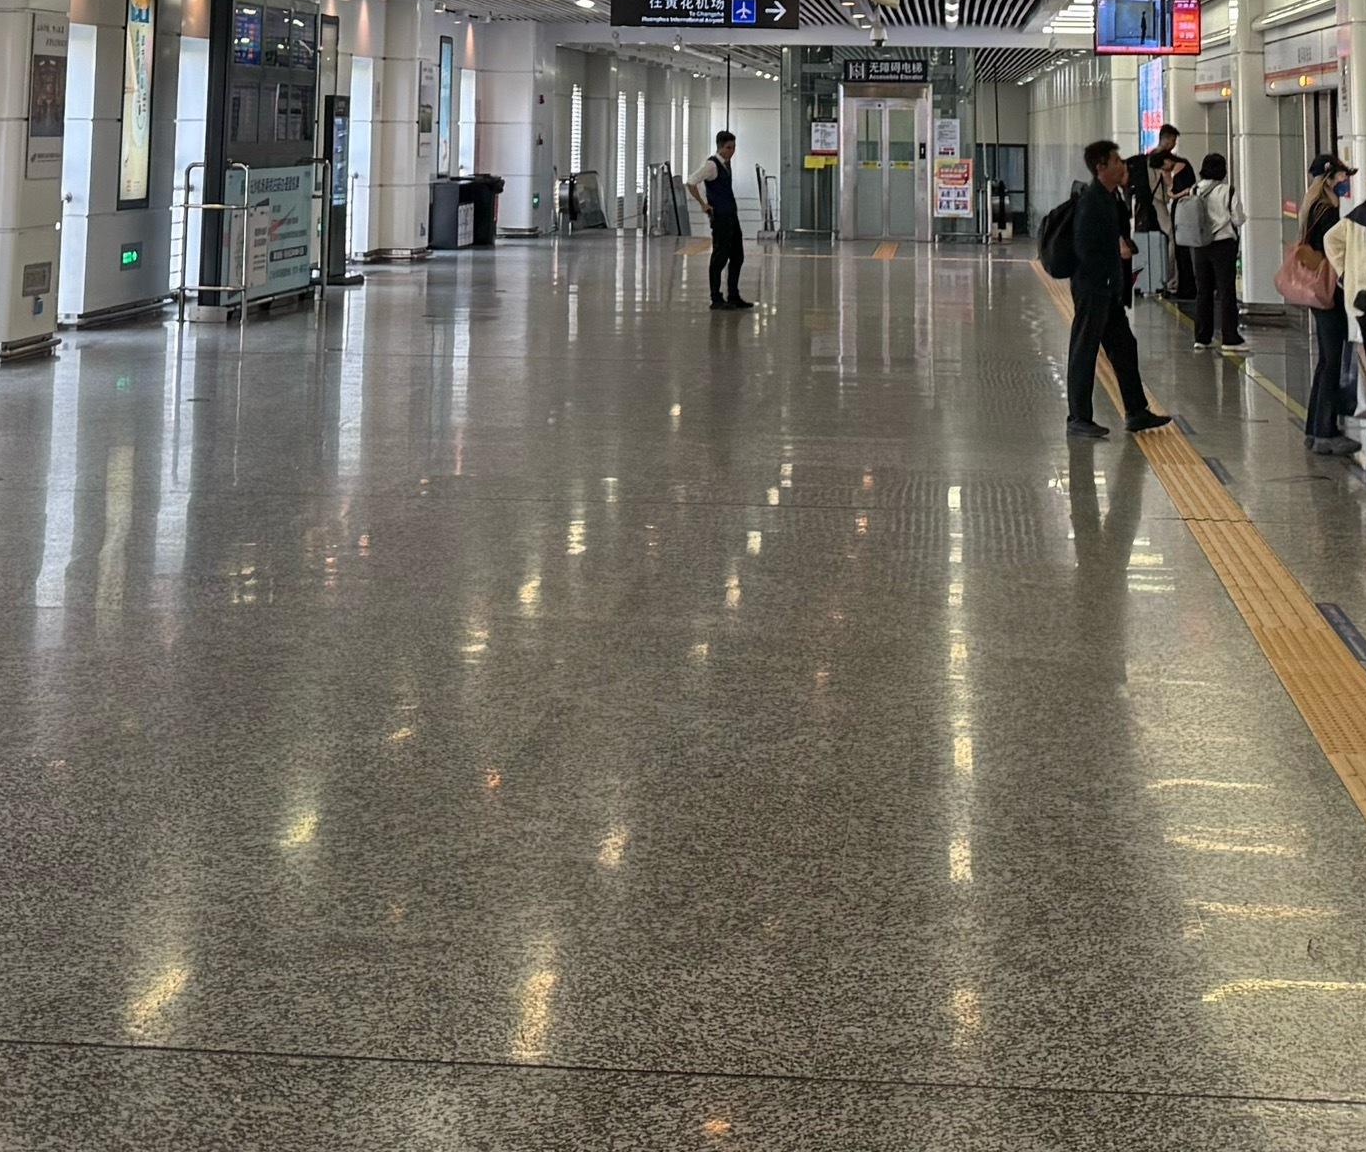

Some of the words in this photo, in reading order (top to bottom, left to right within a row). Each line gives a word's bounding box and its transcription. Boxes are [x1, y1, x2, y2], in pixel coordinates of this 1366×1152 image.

[869, 61, 923, 74] 无障碍电梯
